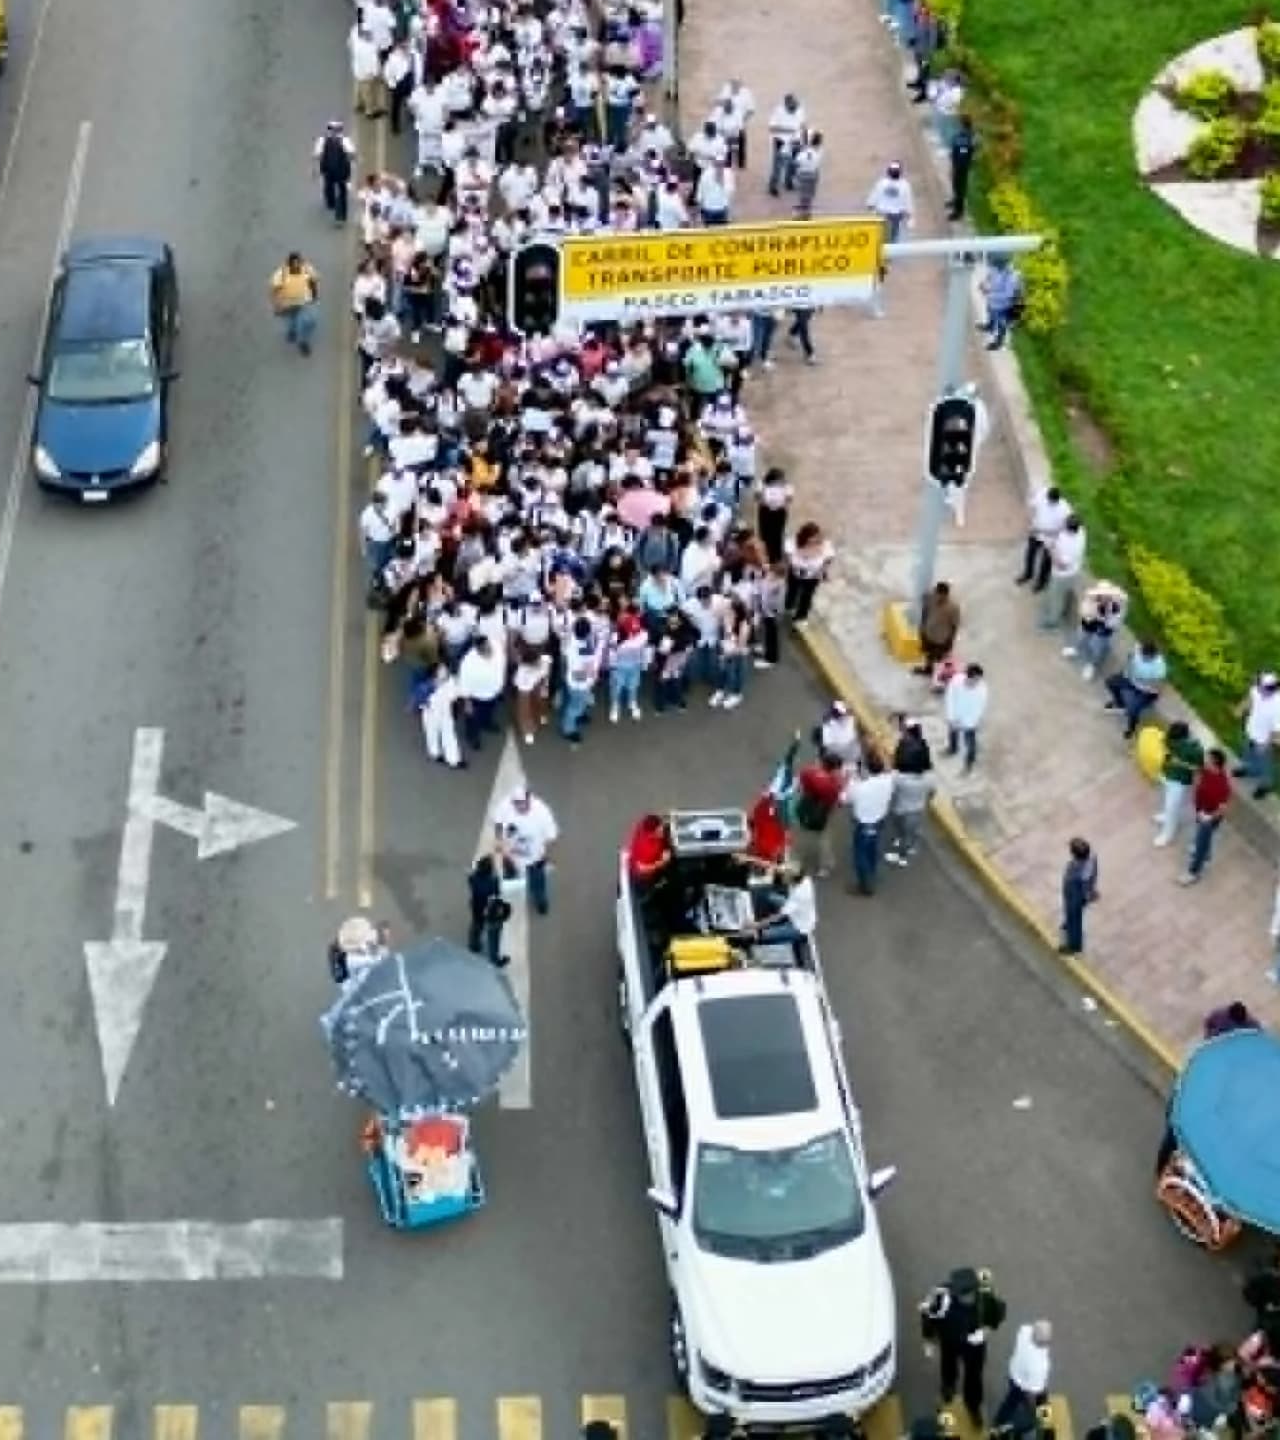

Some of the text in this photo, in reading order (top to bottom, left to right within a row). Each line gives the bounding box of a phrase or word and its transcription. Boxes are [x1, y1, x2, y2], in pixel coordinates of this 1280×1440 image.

[571, 231, 870, 267] CARRIL DE CONTRAFLUJO
[587, 262, 740, 291] TRANSPORTE
